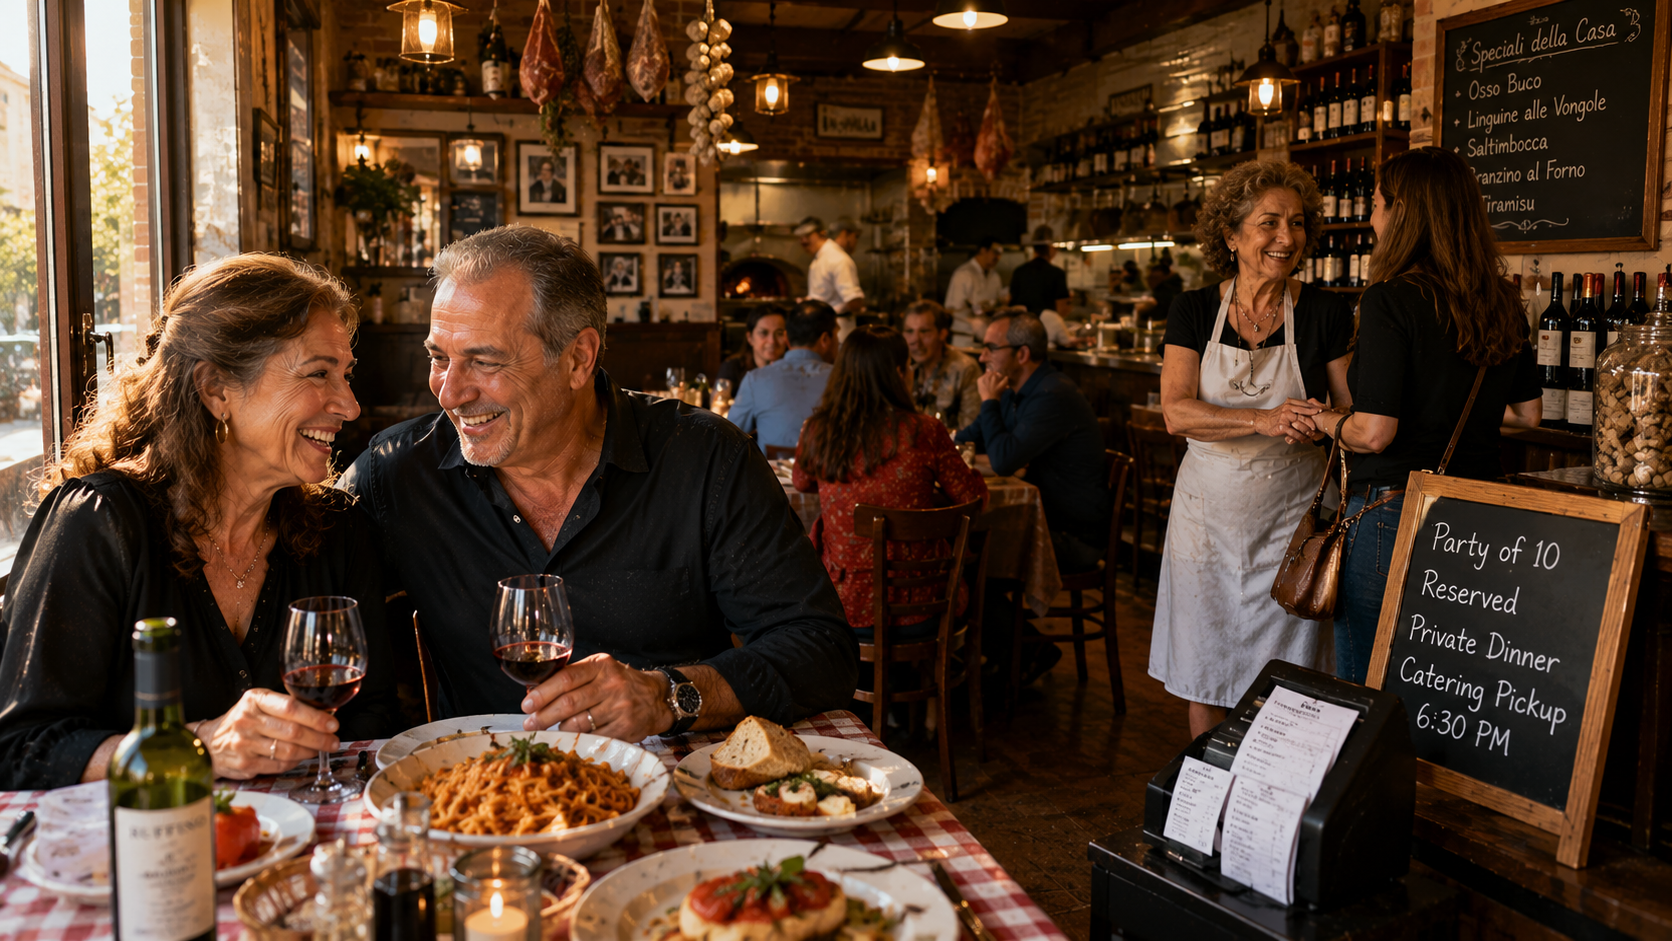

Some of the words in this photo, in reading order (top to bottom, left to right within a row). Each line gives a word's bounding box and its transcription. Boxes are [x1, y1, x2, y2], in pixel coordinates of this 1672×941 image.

[1471, 33, 1524, 73] Speciali
[1531, 24, 1568, 52] della
[1576, 17, 1617, 43] Casa
[1469, 80, 1500, 100] Osso
[1507, 73, 1542, 94] Buco
[1468, 109, 1519, 134] Linguine
[1524, 99, 1548, 121] alle
[1553, 89, 1607, 122] Vongole
[1467, 134, 1549, 158] Saltimbocca
[1527, 161, 1540, 181] al
[1546, 159, 1586, 180] Forno
[1432, 522, 1490, 570] Party
[1499, 536, 1526, 564] of
[1533, 540, 1560, 570] 10
[1421, 569, 1520, 615] Reserved
[1409, 614, 1477, 654] Private
[1486, 632, 1560, 673] Dinner
[1400, 656, 1484, 712] Catering
[1495, 680, 1567, 735] Pickup
[1416, 703, 1466, 739] 6:30
[1475, 720, 1511, 756] PM
